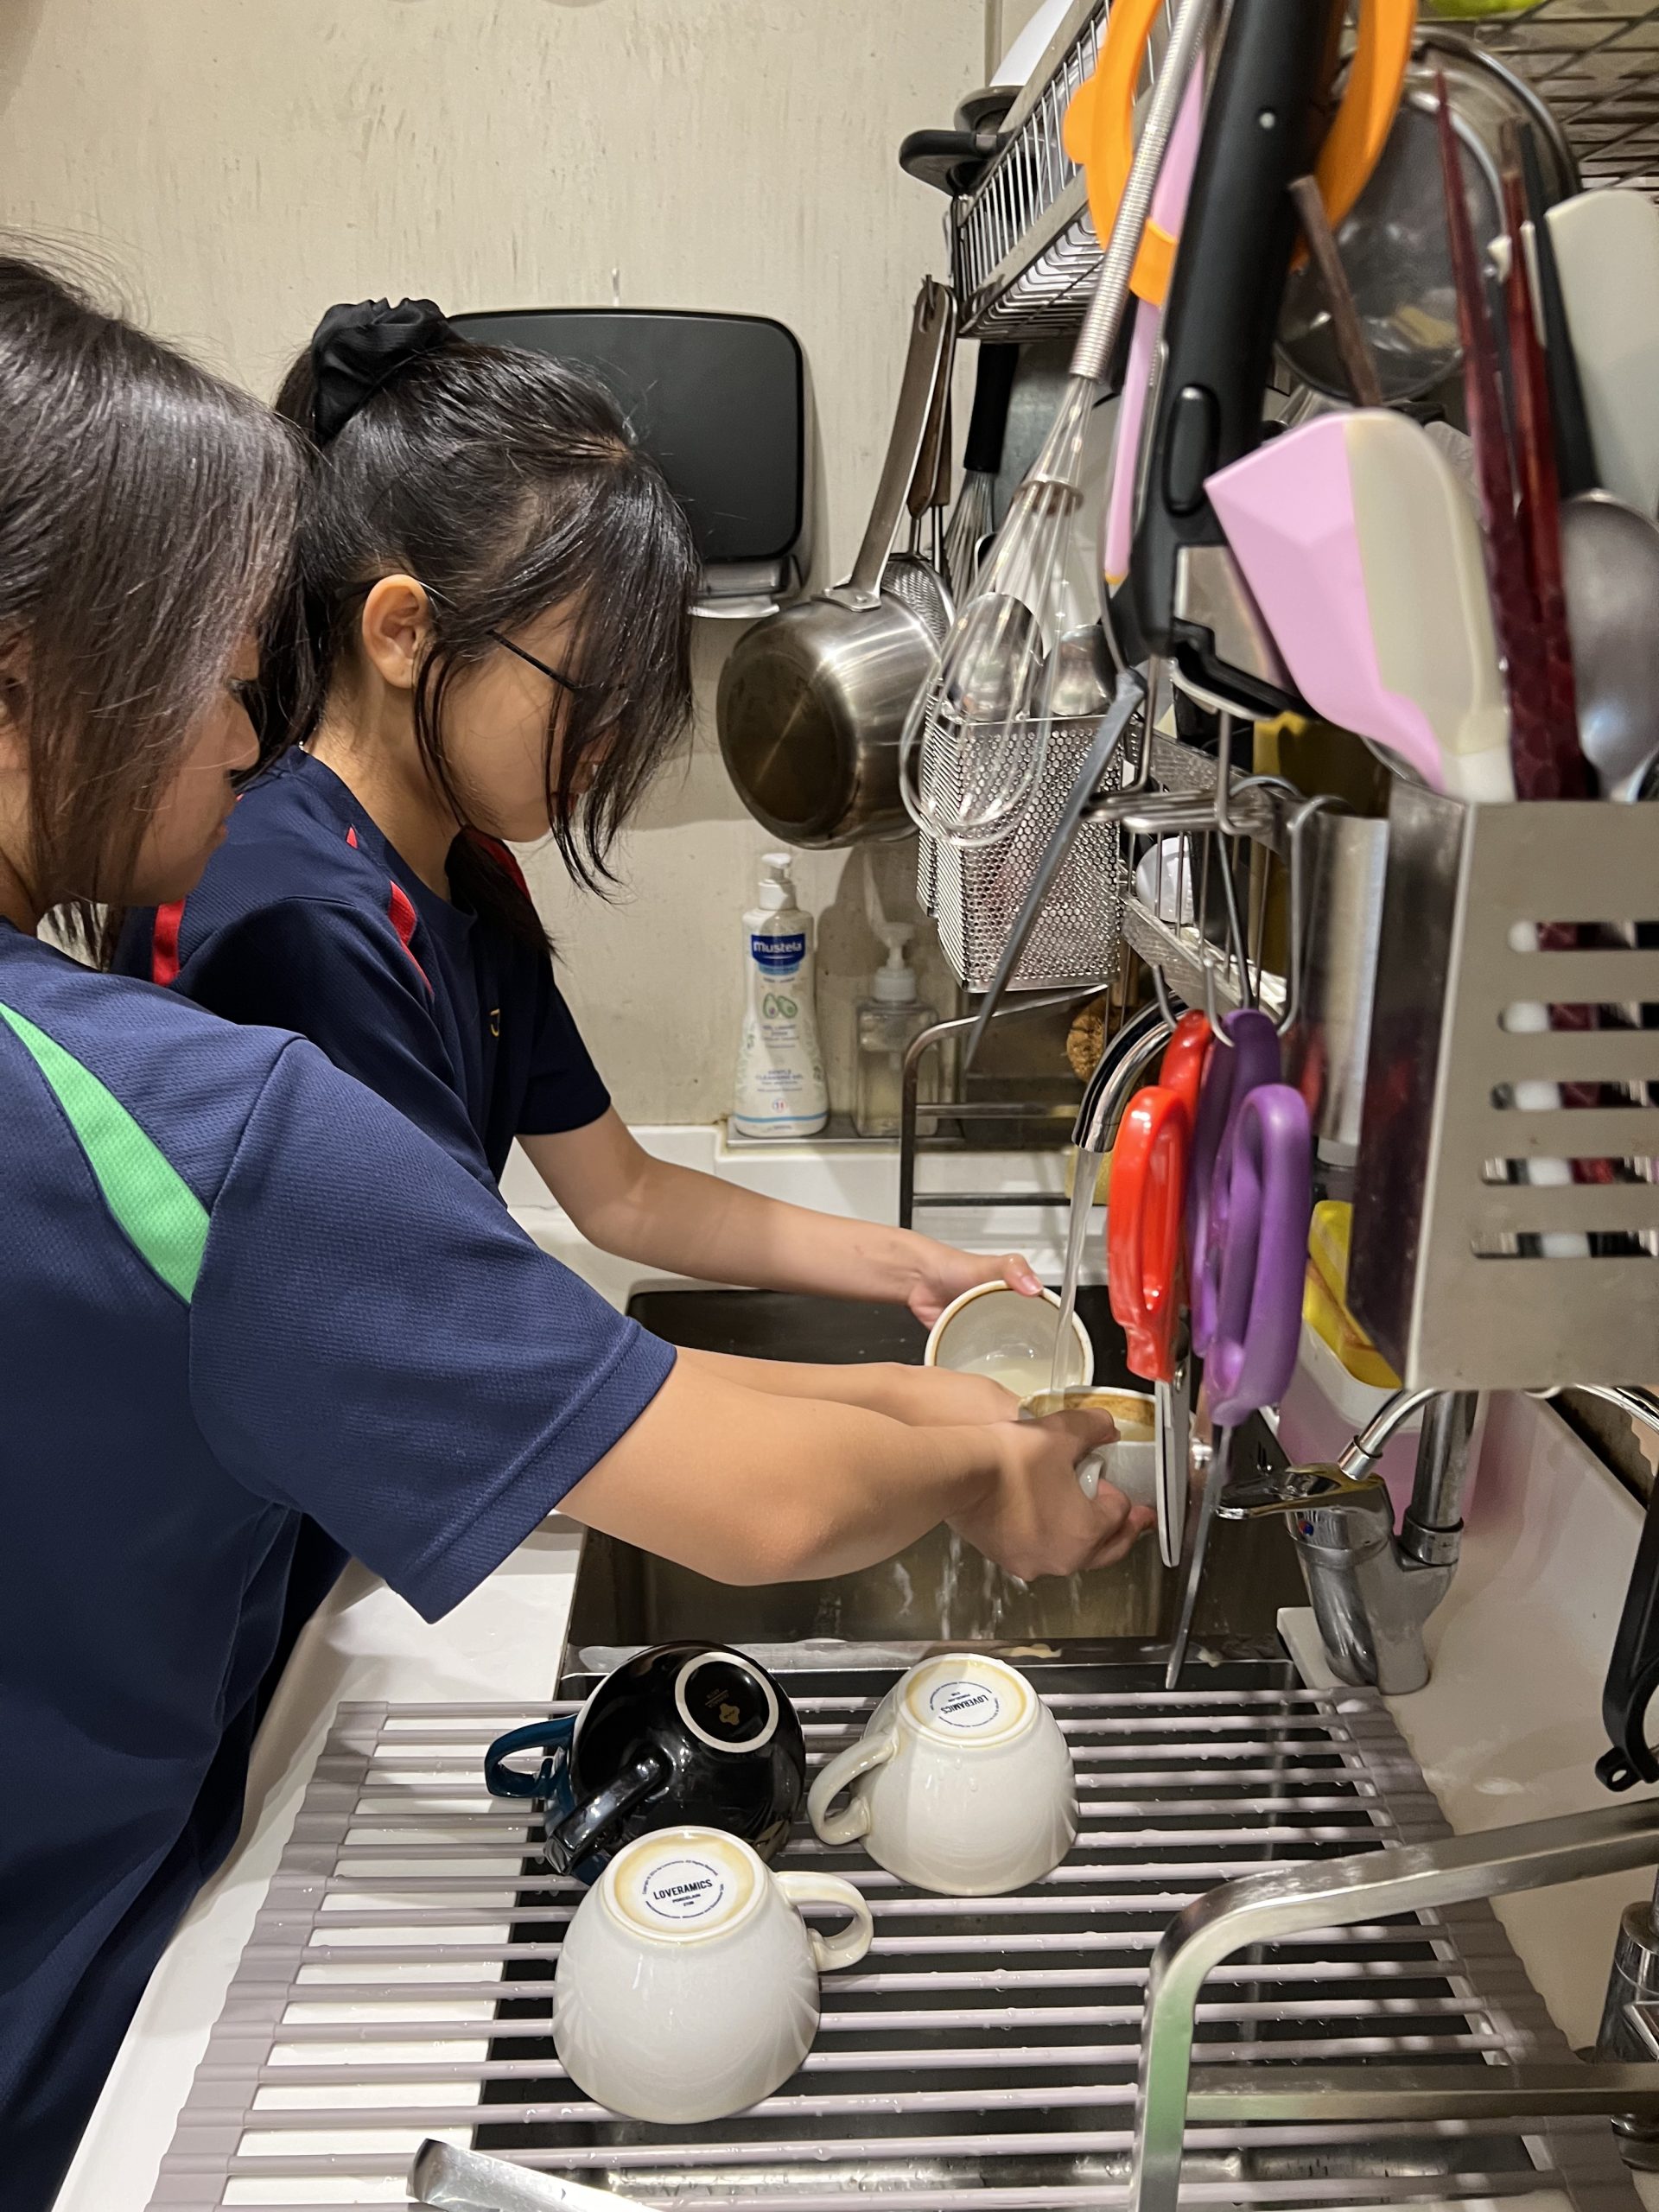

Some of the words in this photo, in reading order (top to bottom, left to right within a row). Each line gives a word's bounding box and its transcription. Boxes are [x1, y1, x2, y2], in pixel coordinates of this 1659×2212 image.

[940, 1694, 988, 1714] LOVERAMICS
[653, 1878, 713, 1900] LOVERAMICS
[672, 1893, 701, 1903] PORCELAIN
